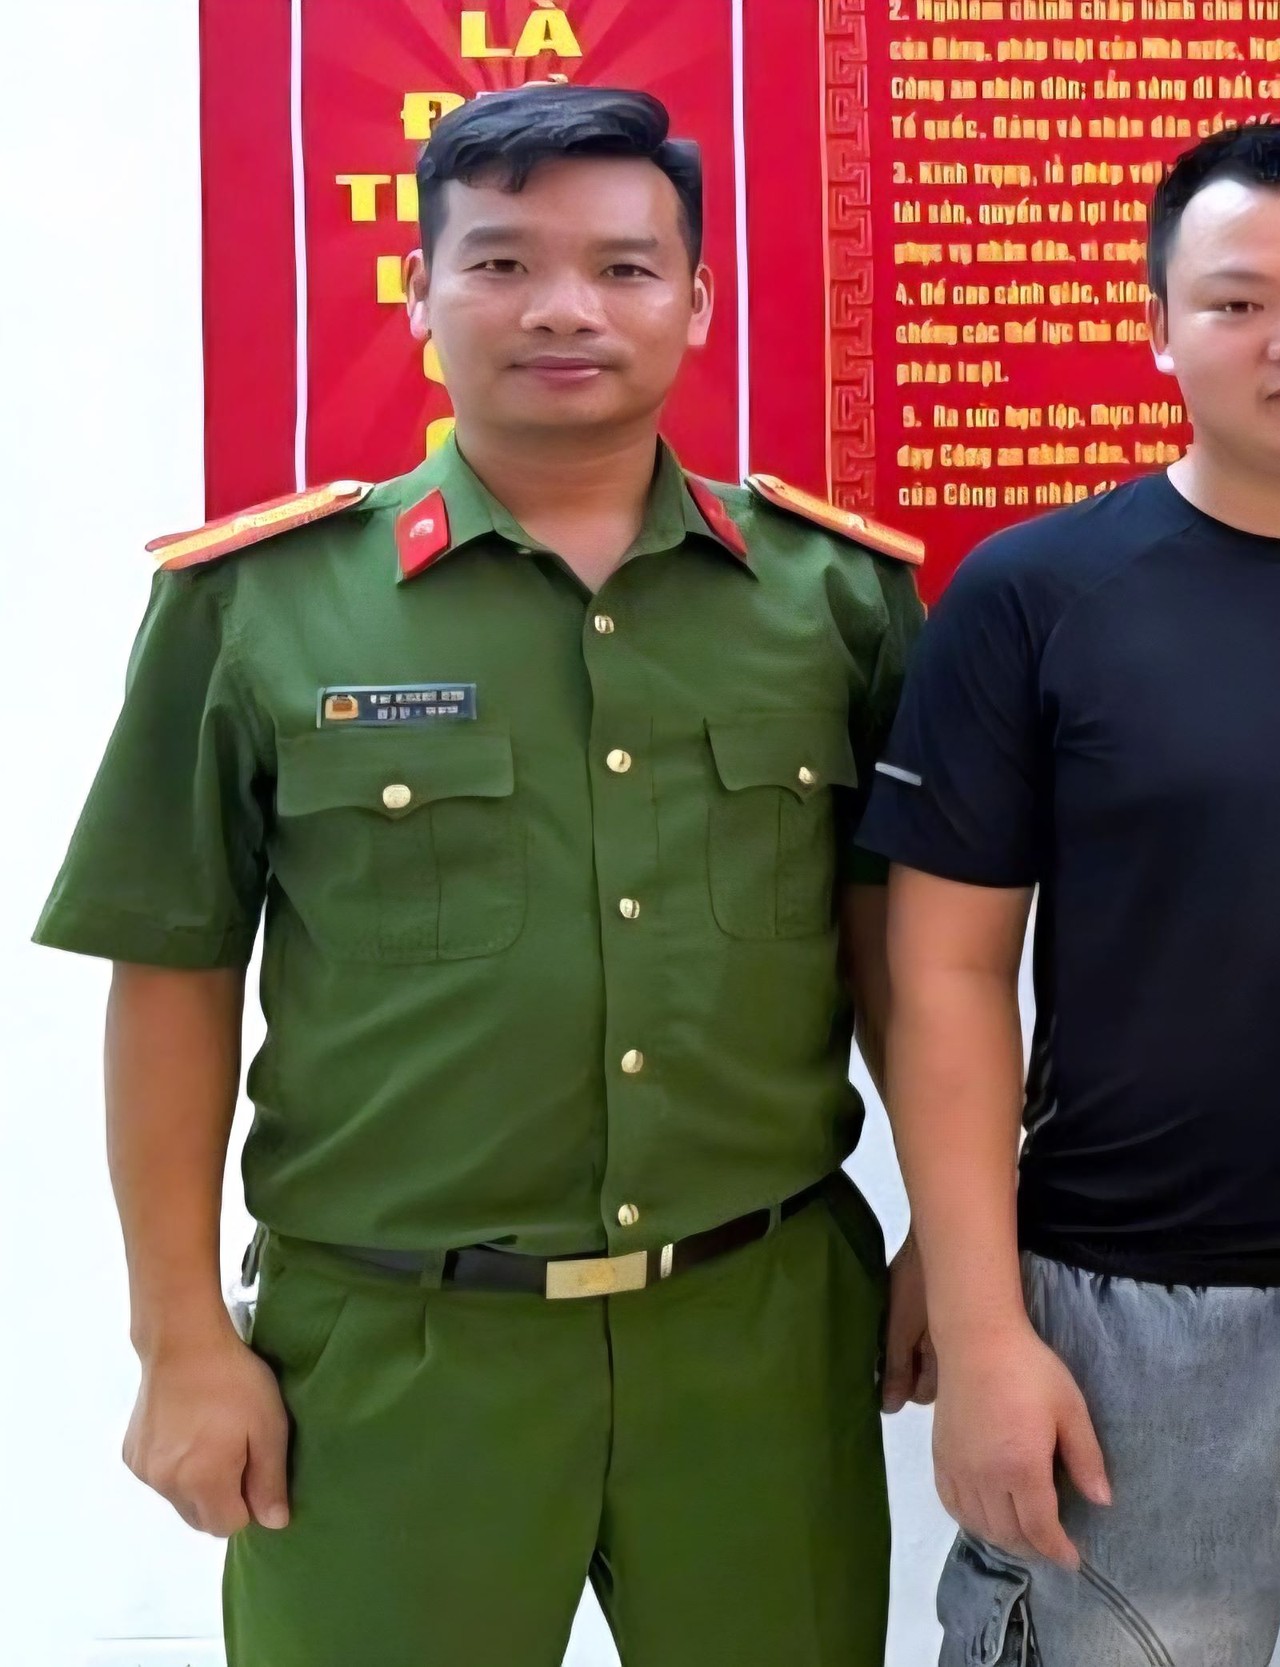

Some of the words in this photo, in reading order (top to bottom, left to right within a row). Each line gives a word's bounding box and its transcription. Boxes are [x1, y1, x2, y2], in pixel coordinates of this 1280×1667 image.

[889, 0, 909, 21] 2.
[460, 0, 583, 58] LÀ
[893, 161, 913, 184] 3.
[895, 282, 914, 305] 4.
[902, 405, 922, 428] 5.
